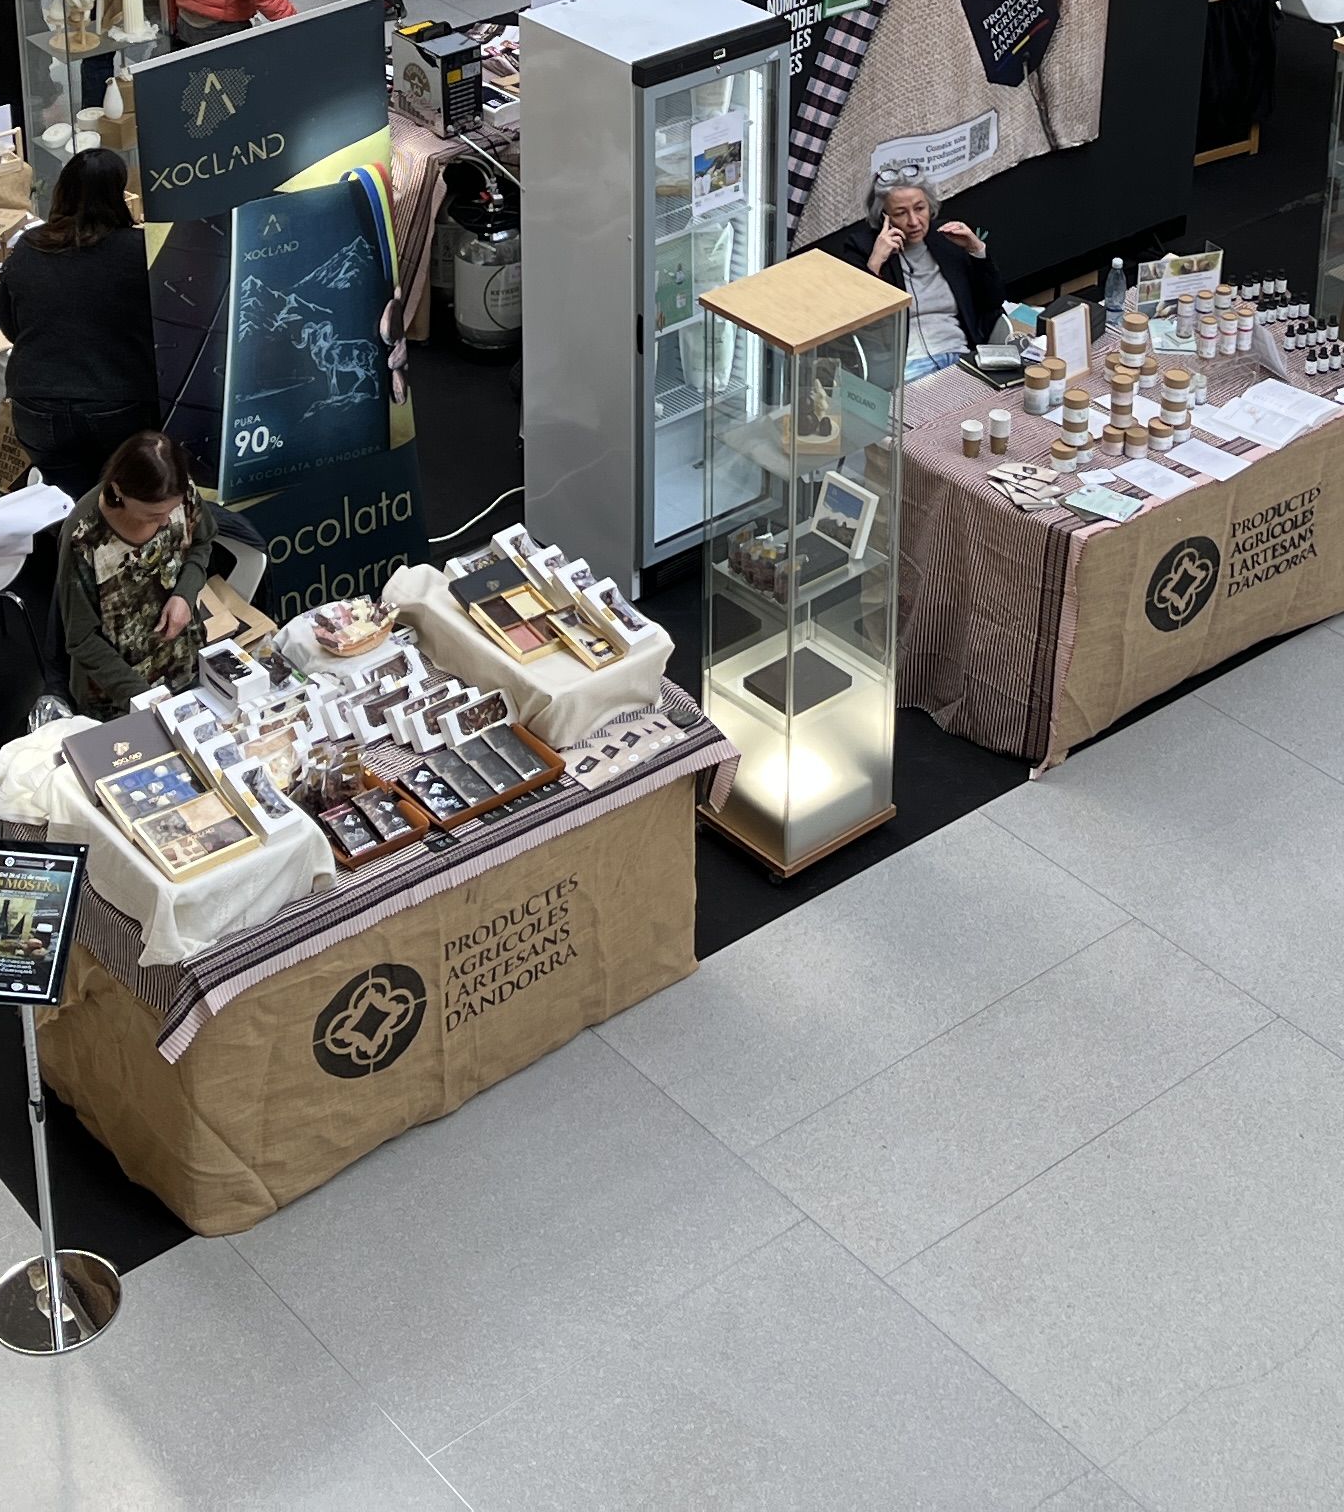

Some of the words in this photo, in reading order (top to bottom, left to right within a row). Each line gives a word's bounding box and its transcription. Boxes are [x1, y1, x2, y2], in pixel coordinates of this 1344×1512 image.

[784, 2, 823, 31] ODEN
[149, 132, 286, 193] XOCLAND
[242, 240, 300, 263] XOCLAND
[234, 413, 262, 429] PURA
[234, 425, 285, 458] 90%
[229, 476, 246, 488] LA
[248, 461, 312, 483] XOCOLATA
[315, 444, 383, 469] D'ANDORRA
[267, 490, 413, 565] ocolata
[1230, 481, 1322, 538] PRODUCTES
[1230, 505, 1315, 559] AGRÍCOLES
[1228, 562, 1236, 579] I
[1239, 523, 1315, 576] ARTESANS
[274, 552, 410, 623] ndorra
[4, 877, 62, 893] MOSTRA
[443, 871, 579, 962] PRODUCTES
[445, 899, 570, 987] AGRÍCOLES
[444, 989, 450, 1010] I
[454, 921, 571, 1005] ARTESANS
[445, 943, 579, 1034] D'ANDORRA
